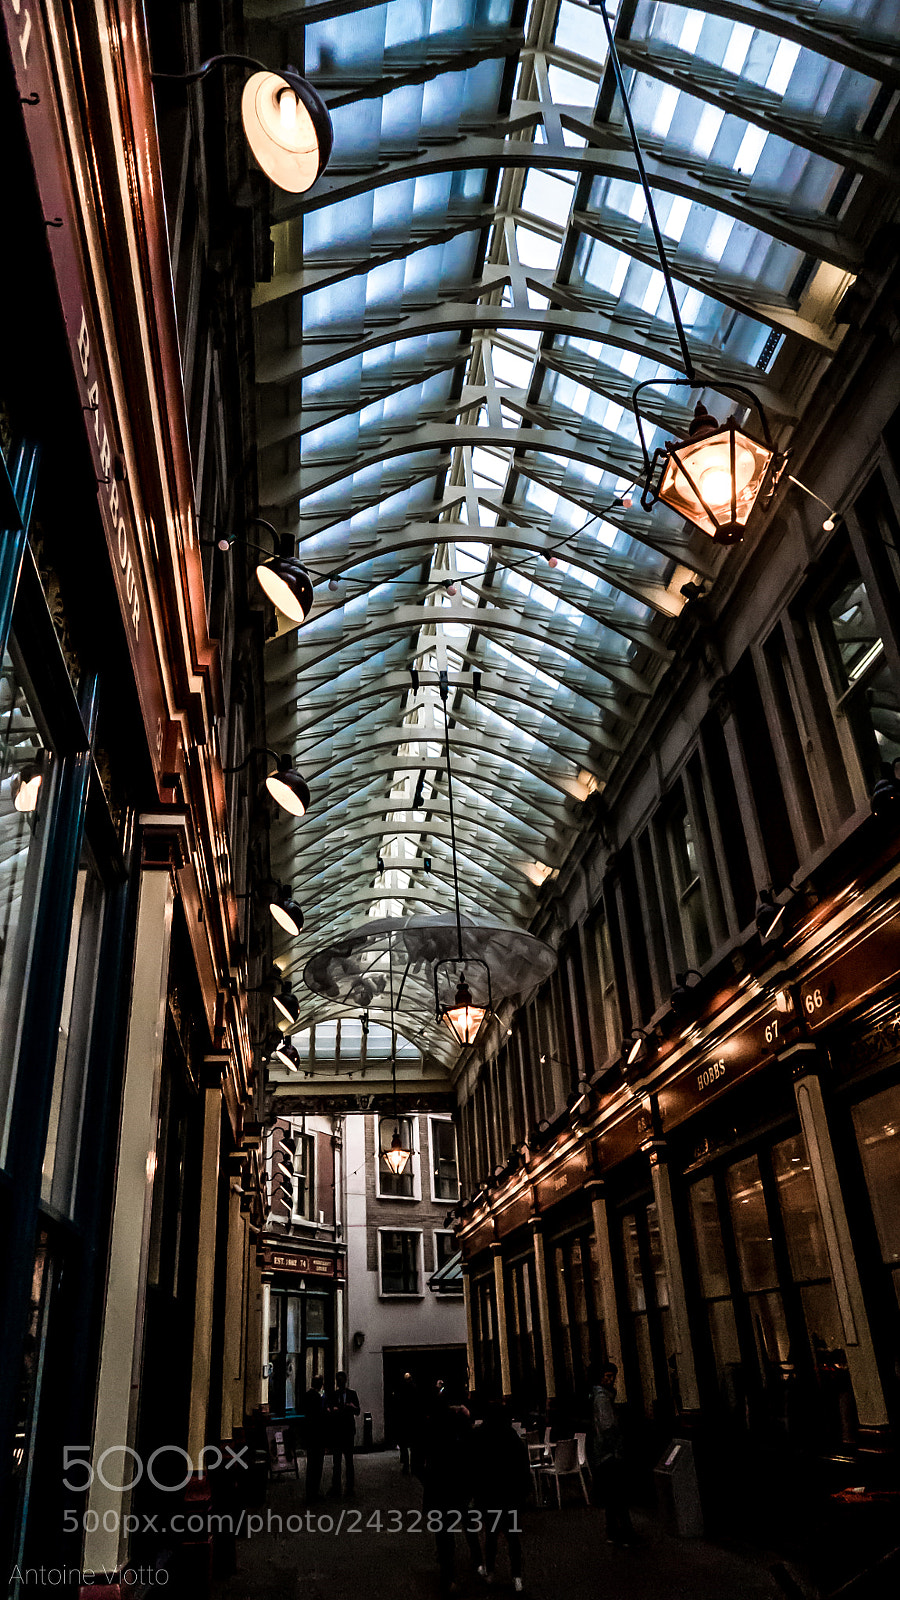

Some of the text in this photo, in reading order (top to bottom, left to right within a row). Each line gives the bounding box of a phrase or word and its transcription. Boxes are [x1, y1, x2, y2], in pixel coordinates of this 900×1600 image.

[77, 304, 140, 643] BARBOUR
[805, 988, 823, 1014] 66
[764, 1019, 779, 1043] 67
[696, 1058, 726, 1092] HOBBS
